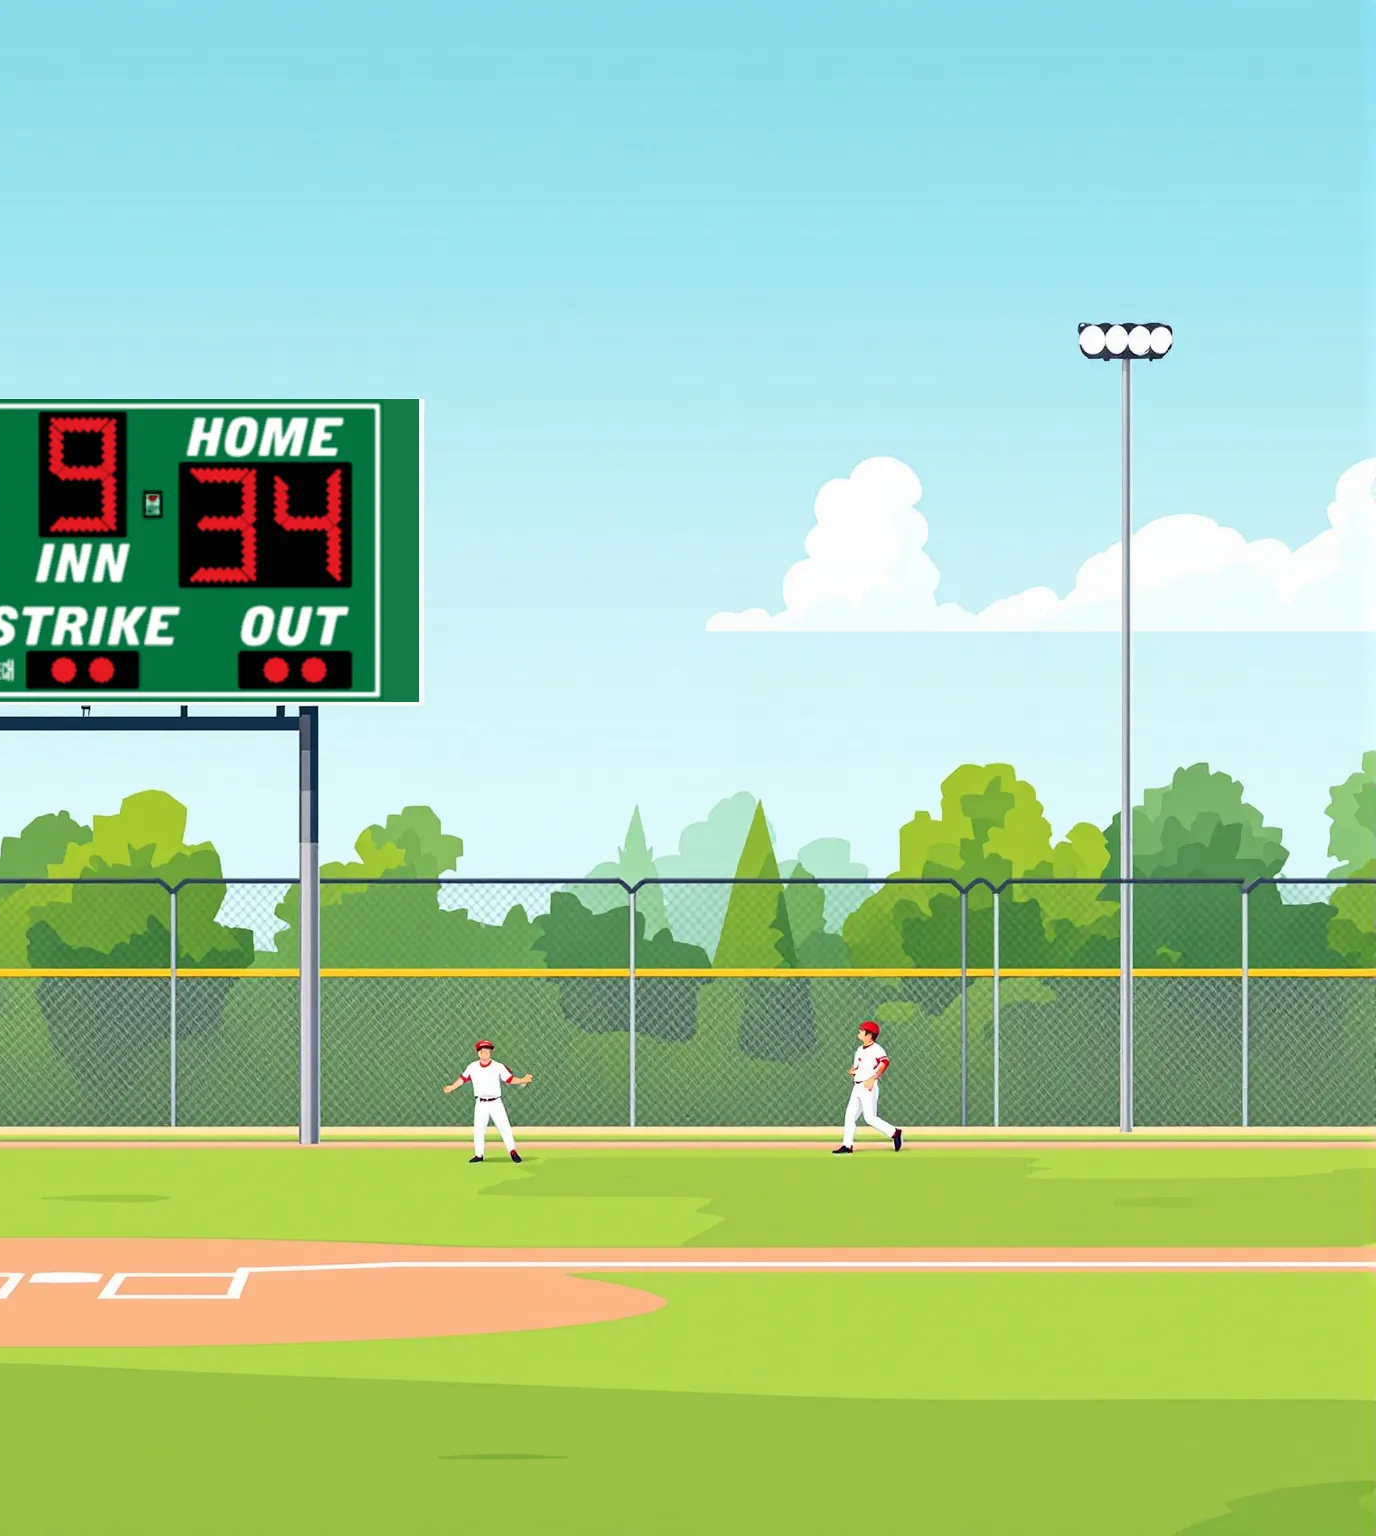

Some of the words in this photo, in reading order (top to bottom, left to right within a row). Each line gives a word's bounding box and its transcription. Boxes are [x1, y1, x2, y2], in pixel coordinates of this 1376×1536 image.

[186, 417, 344, 457] HOME
[49, 418, 116, 532] 9
[190, 467, 342, 582] 34
[35, 543, 130, 582] INN
[240, 606, 349, 646] OUT
